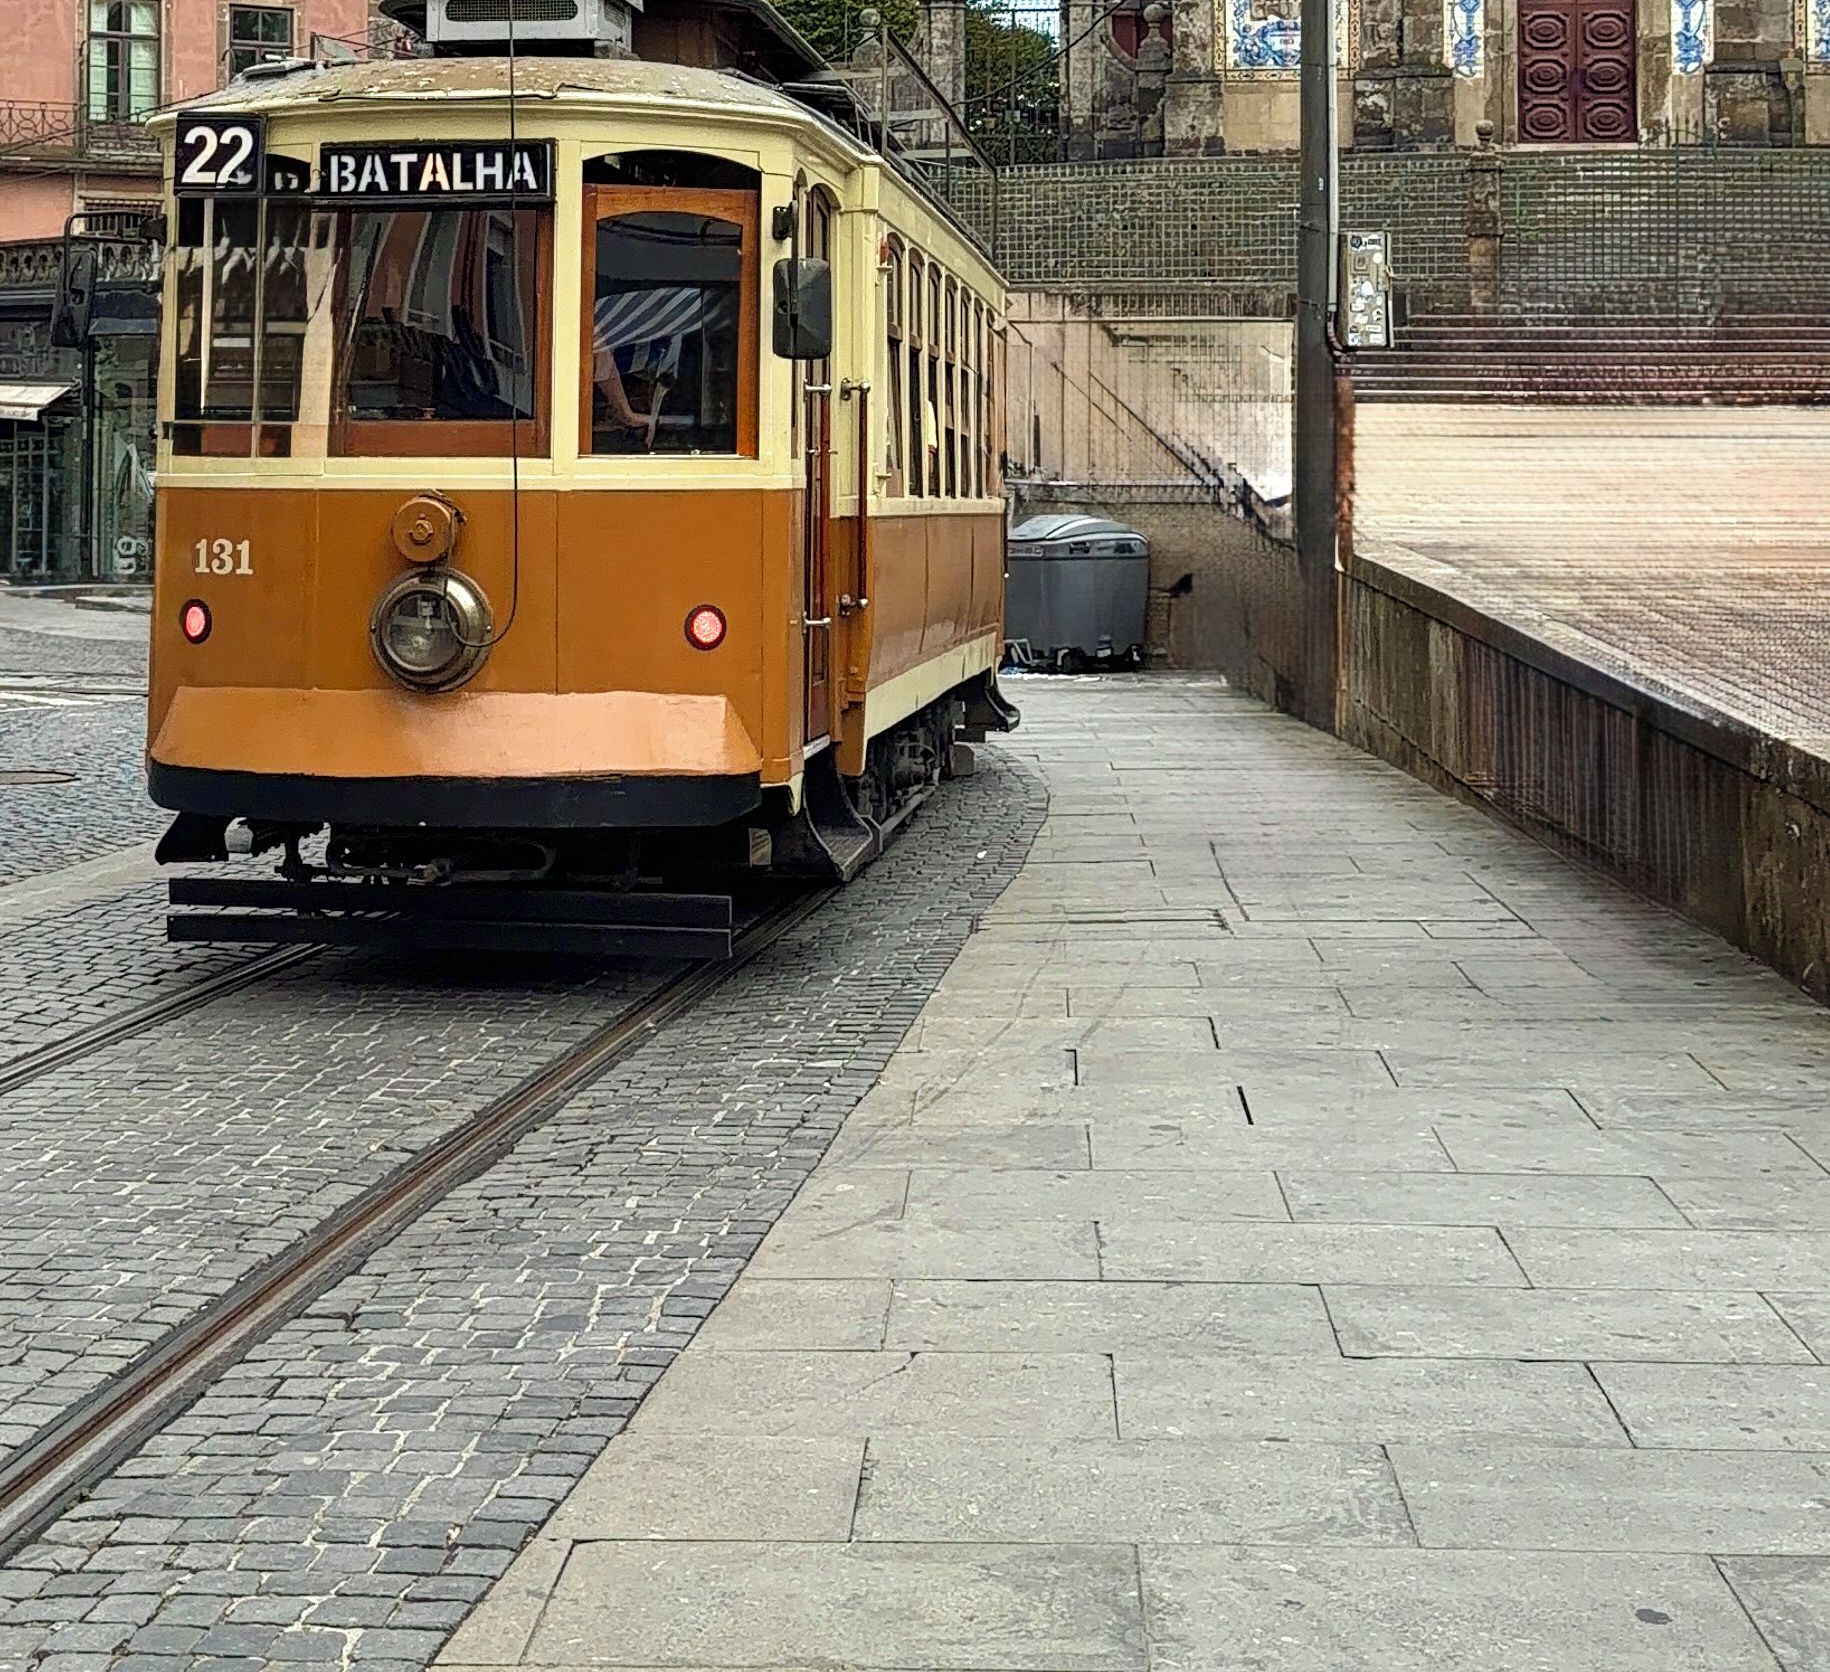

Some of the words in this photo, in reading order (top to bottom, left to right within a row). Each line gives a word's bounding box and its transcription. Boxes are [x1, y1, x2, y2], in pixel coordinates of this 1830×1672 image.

[181, 125, 254, 185] 22
[330, 151, 538, 193] BATALHA
[195, 538, 254, 575] 131
